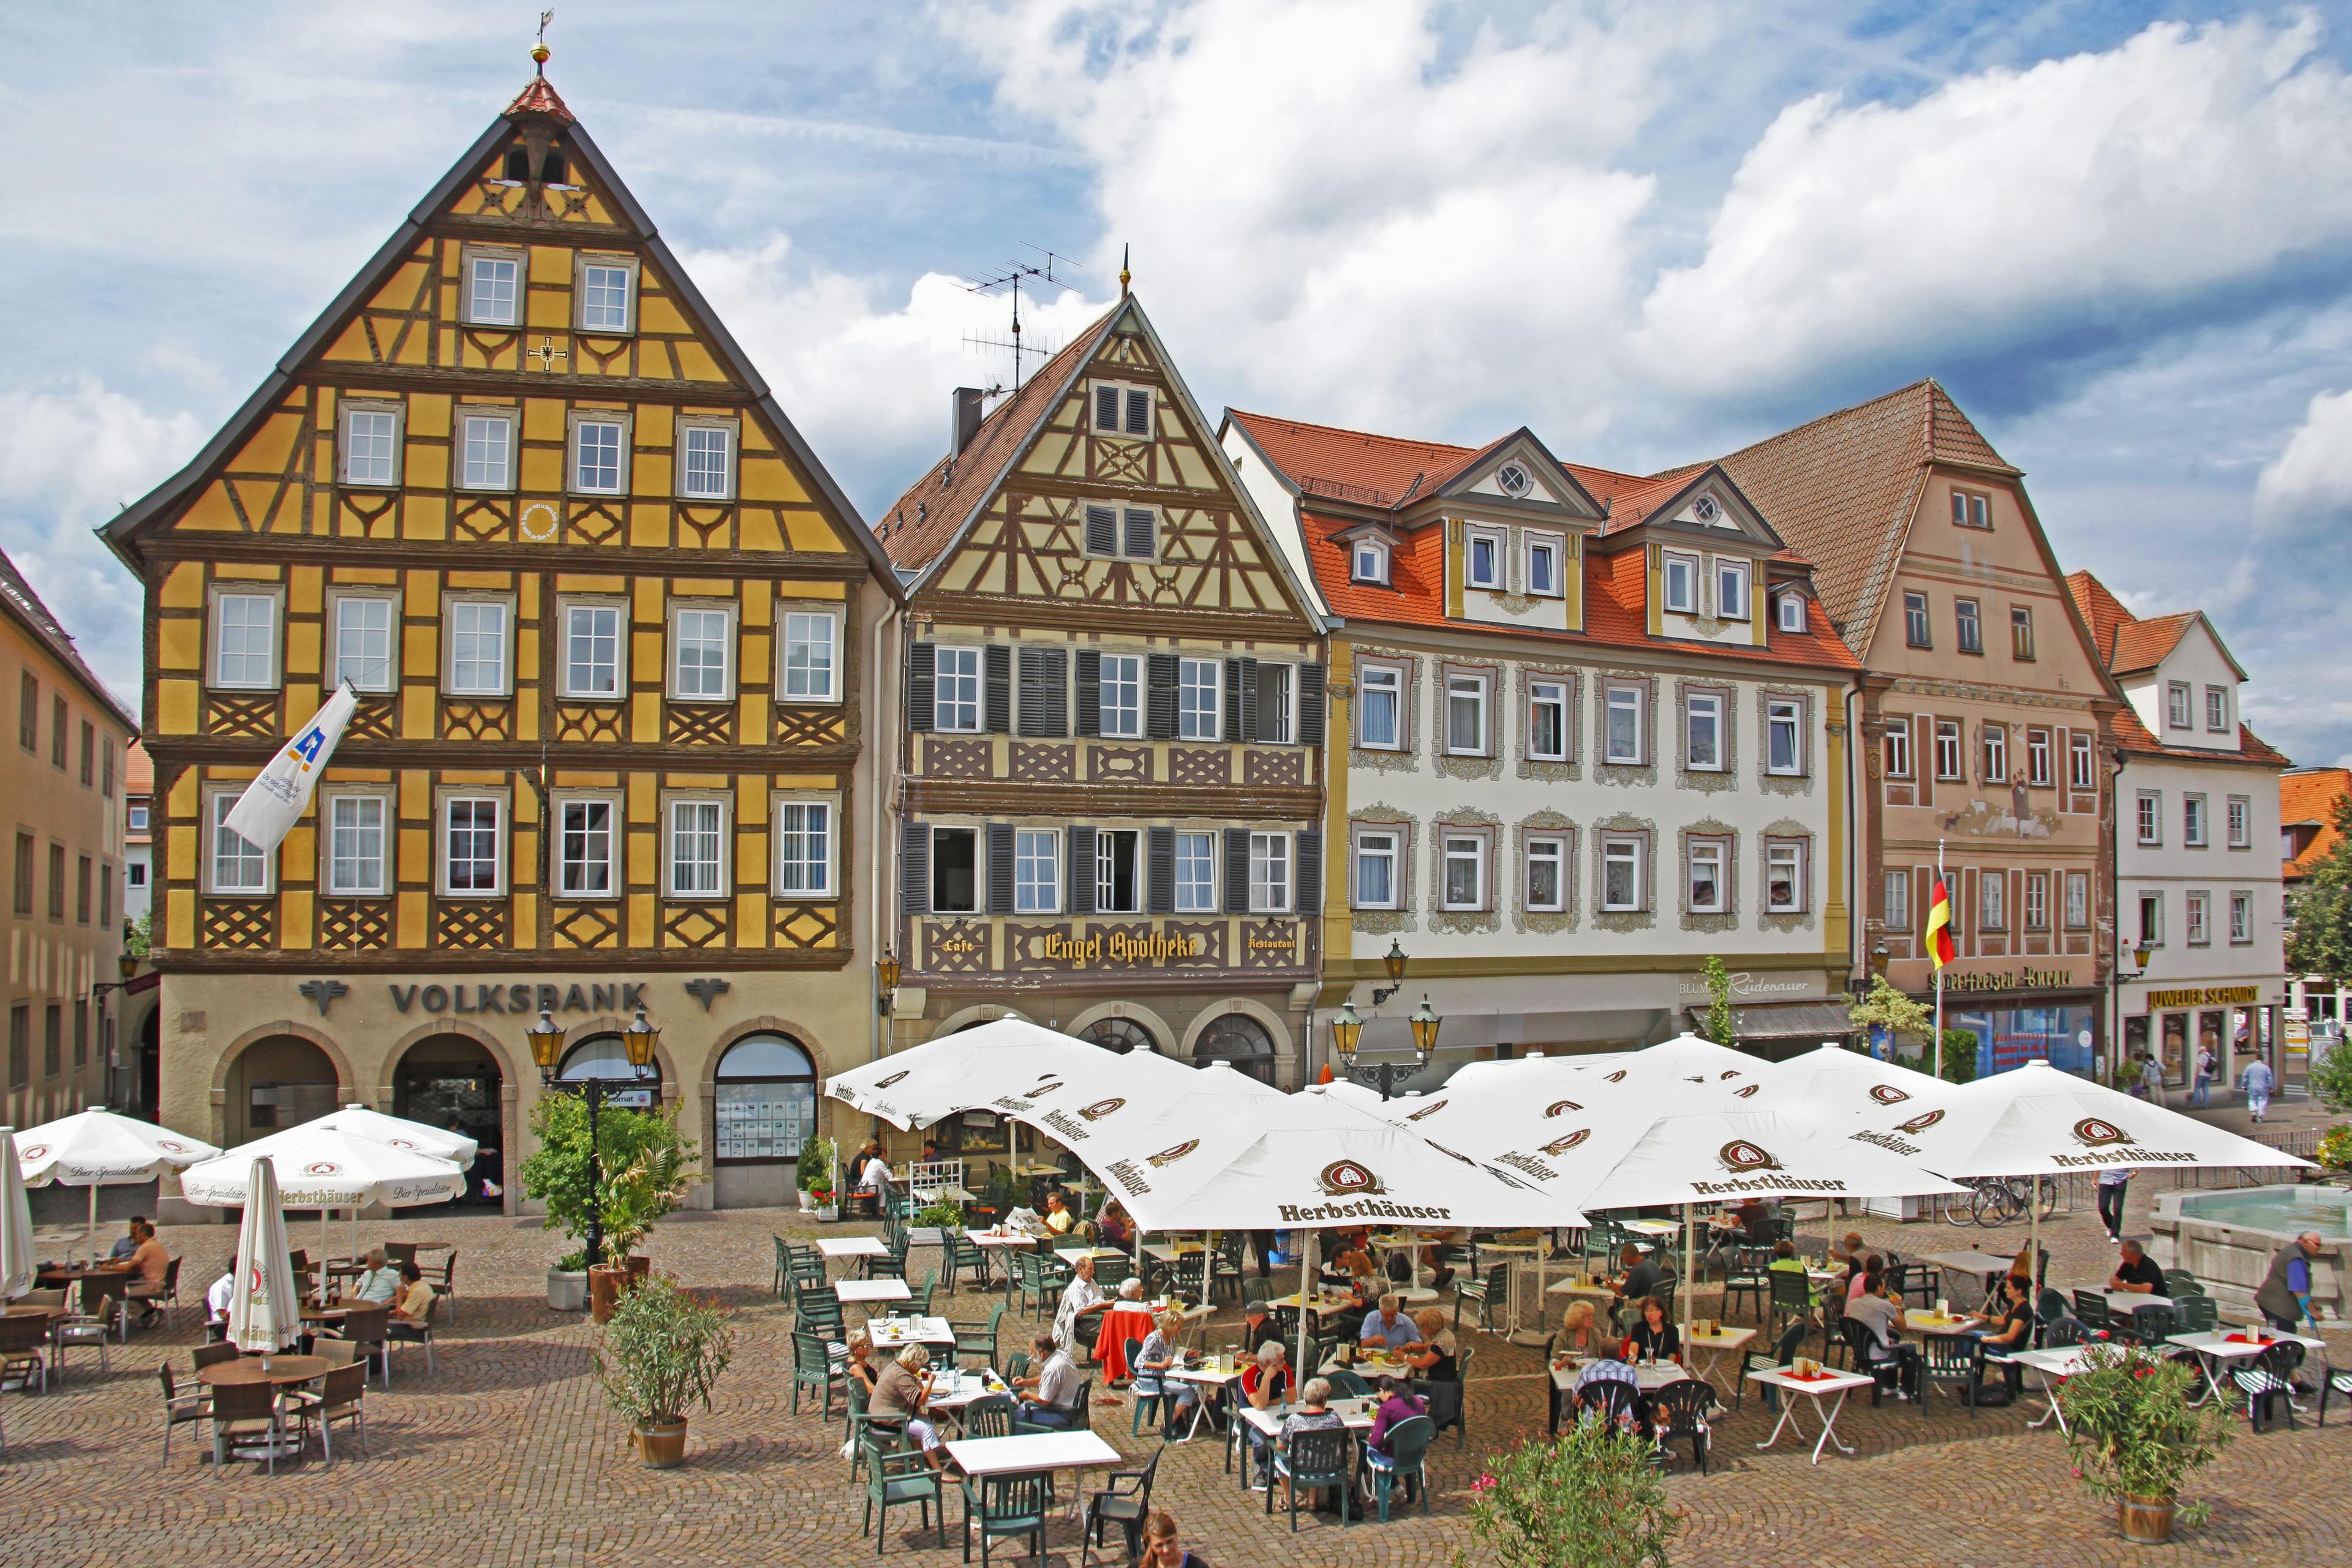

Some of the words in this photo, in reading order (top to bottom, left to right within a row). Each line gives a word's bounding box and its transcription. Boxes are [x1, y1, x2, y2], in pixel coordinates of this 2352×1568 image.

[944, 939, 974, 952] Cafe
[1044, 930, 1101, 965] Engel
[1109, 930, 1197, 963] Apotheke
[1248, 938, 1295, 949] Restaurant
[1727, 972, 1809, 995] Rüdenauer
[2024, 966, 2074, 989] Burger
[388, 982, 648, 1013] VOLKSBANK
[2148, 989, 2204, 1010] JUWELIER
[2207, 986, 2260, 1005] SCHMIDT
[1041, 1109, 1090, 1142] Herbsthäuser
[2049, 1147, 2199, 1167] Herbsthäuser
[189, 1183, 246, 1201] Bier-Spezialitäte
[1690, 1174, 1847, 1194] Herbsthäuser
[1278, 1199, 1452, 1221] Herbsthäuser
